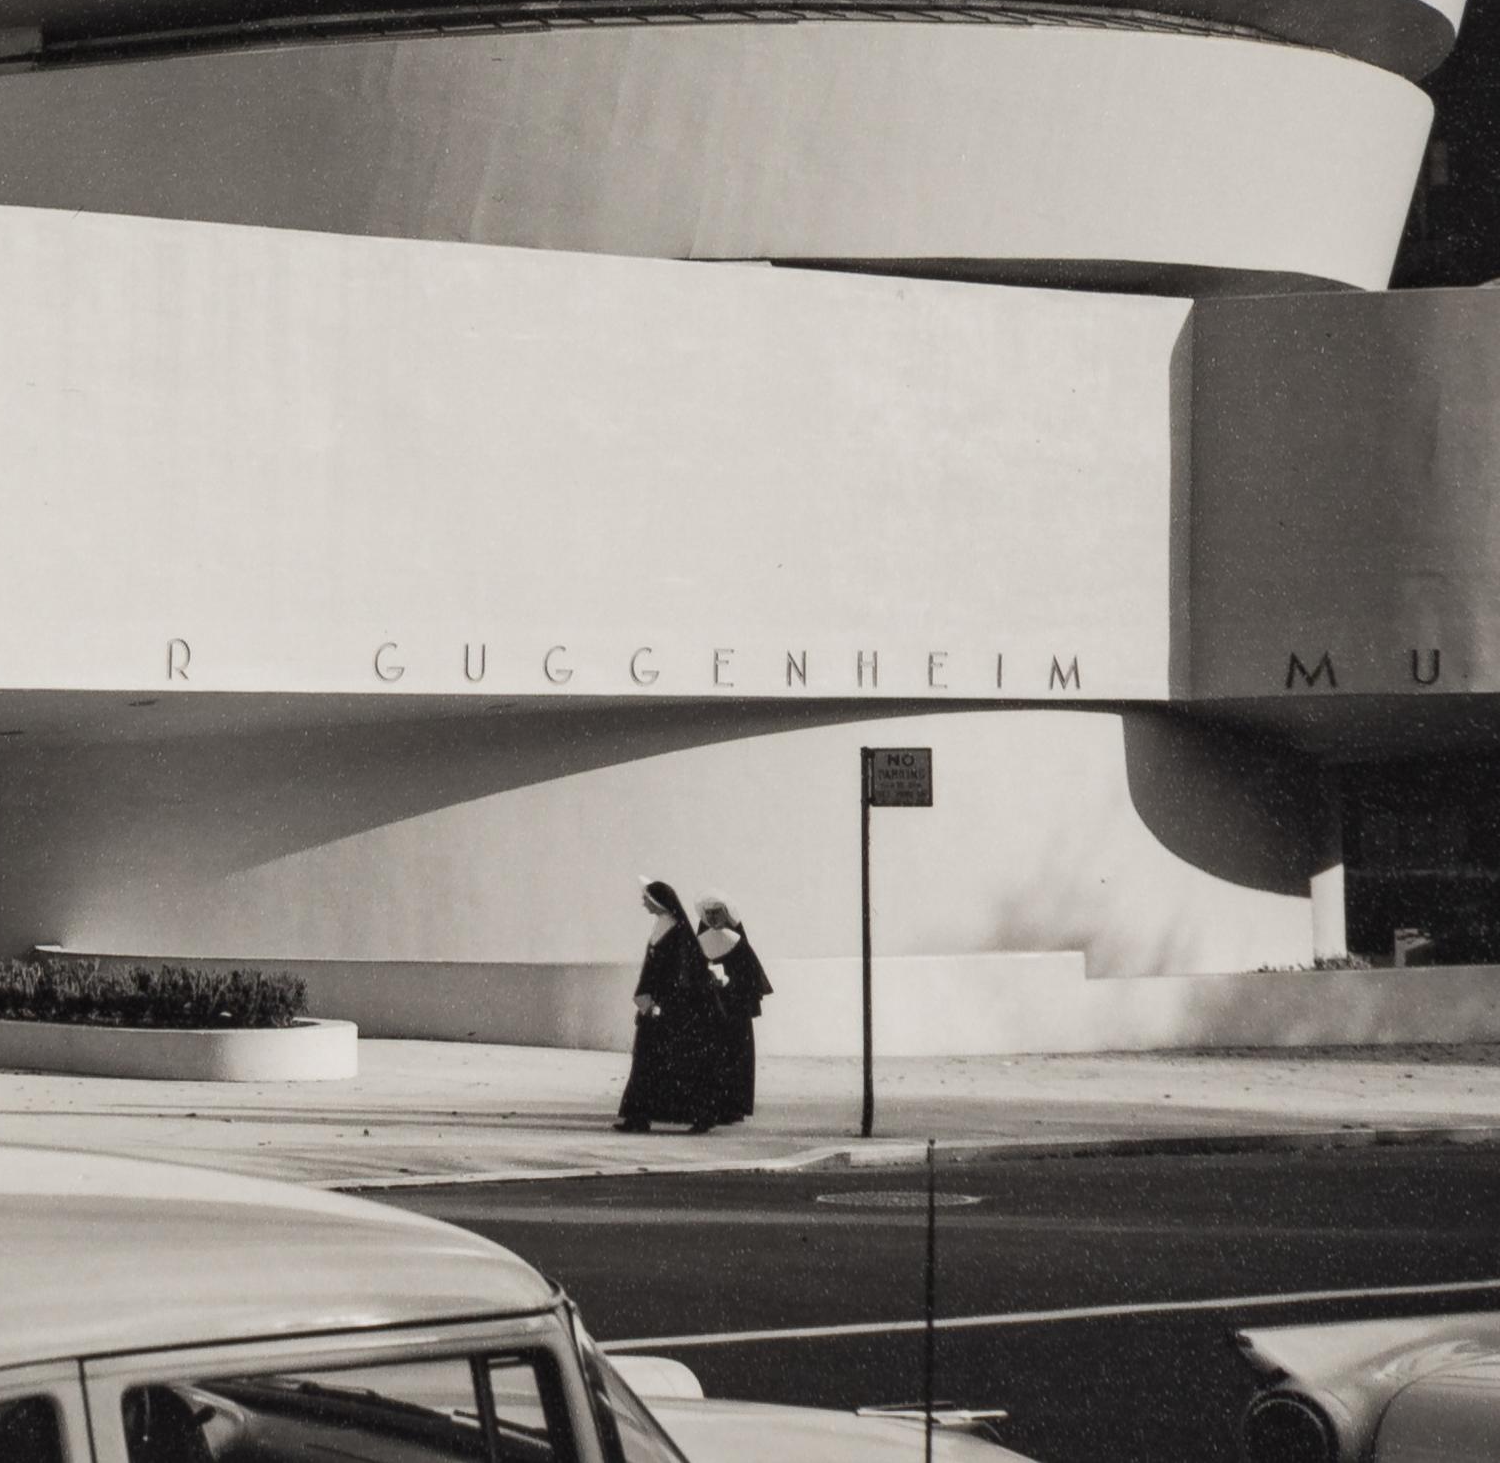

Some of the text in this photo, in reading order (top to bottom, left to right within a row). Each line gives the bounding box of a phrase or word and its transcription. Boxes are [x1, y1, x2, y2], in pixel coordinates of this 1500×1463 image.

[166, 638, 193, 682] R
[372, 640, 1083, 692] GUGGENHEIM
[1285, 649, 1441, 690] MU
[887, 753, 915, 767] NO
